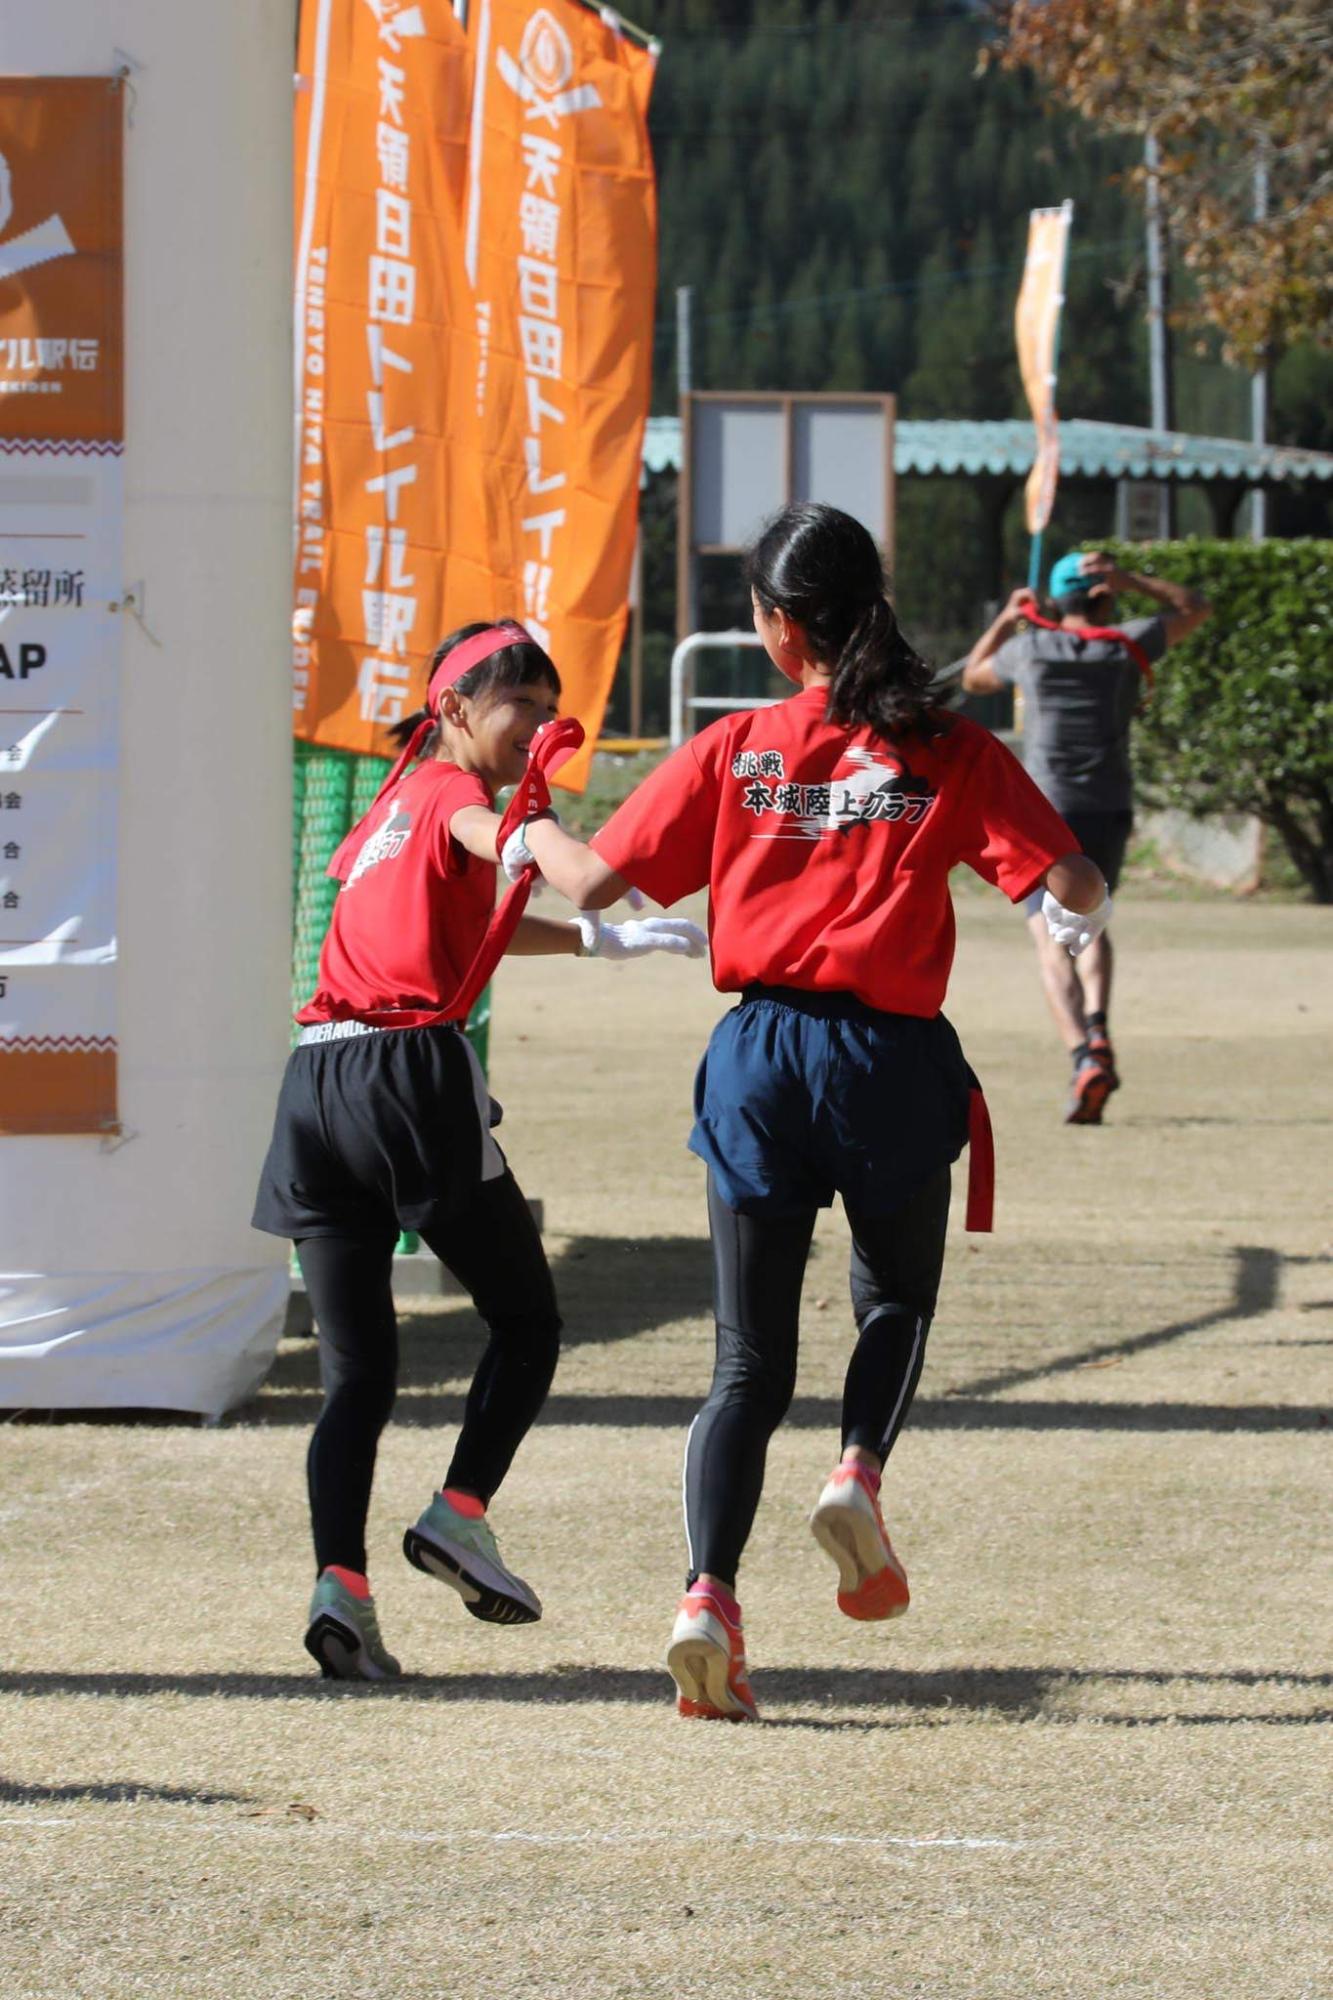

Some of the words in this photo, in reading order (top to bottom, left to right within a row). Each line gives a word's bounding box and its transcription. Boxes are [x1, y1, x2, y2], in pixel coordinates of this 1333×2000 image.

[0, 338, 98, 371] ル駅伝
[732, 750, 784, 778] 挑戦
[0, 791, 21, 809] 会
[743, 781, 936, 824] 本城陸上クラブ
